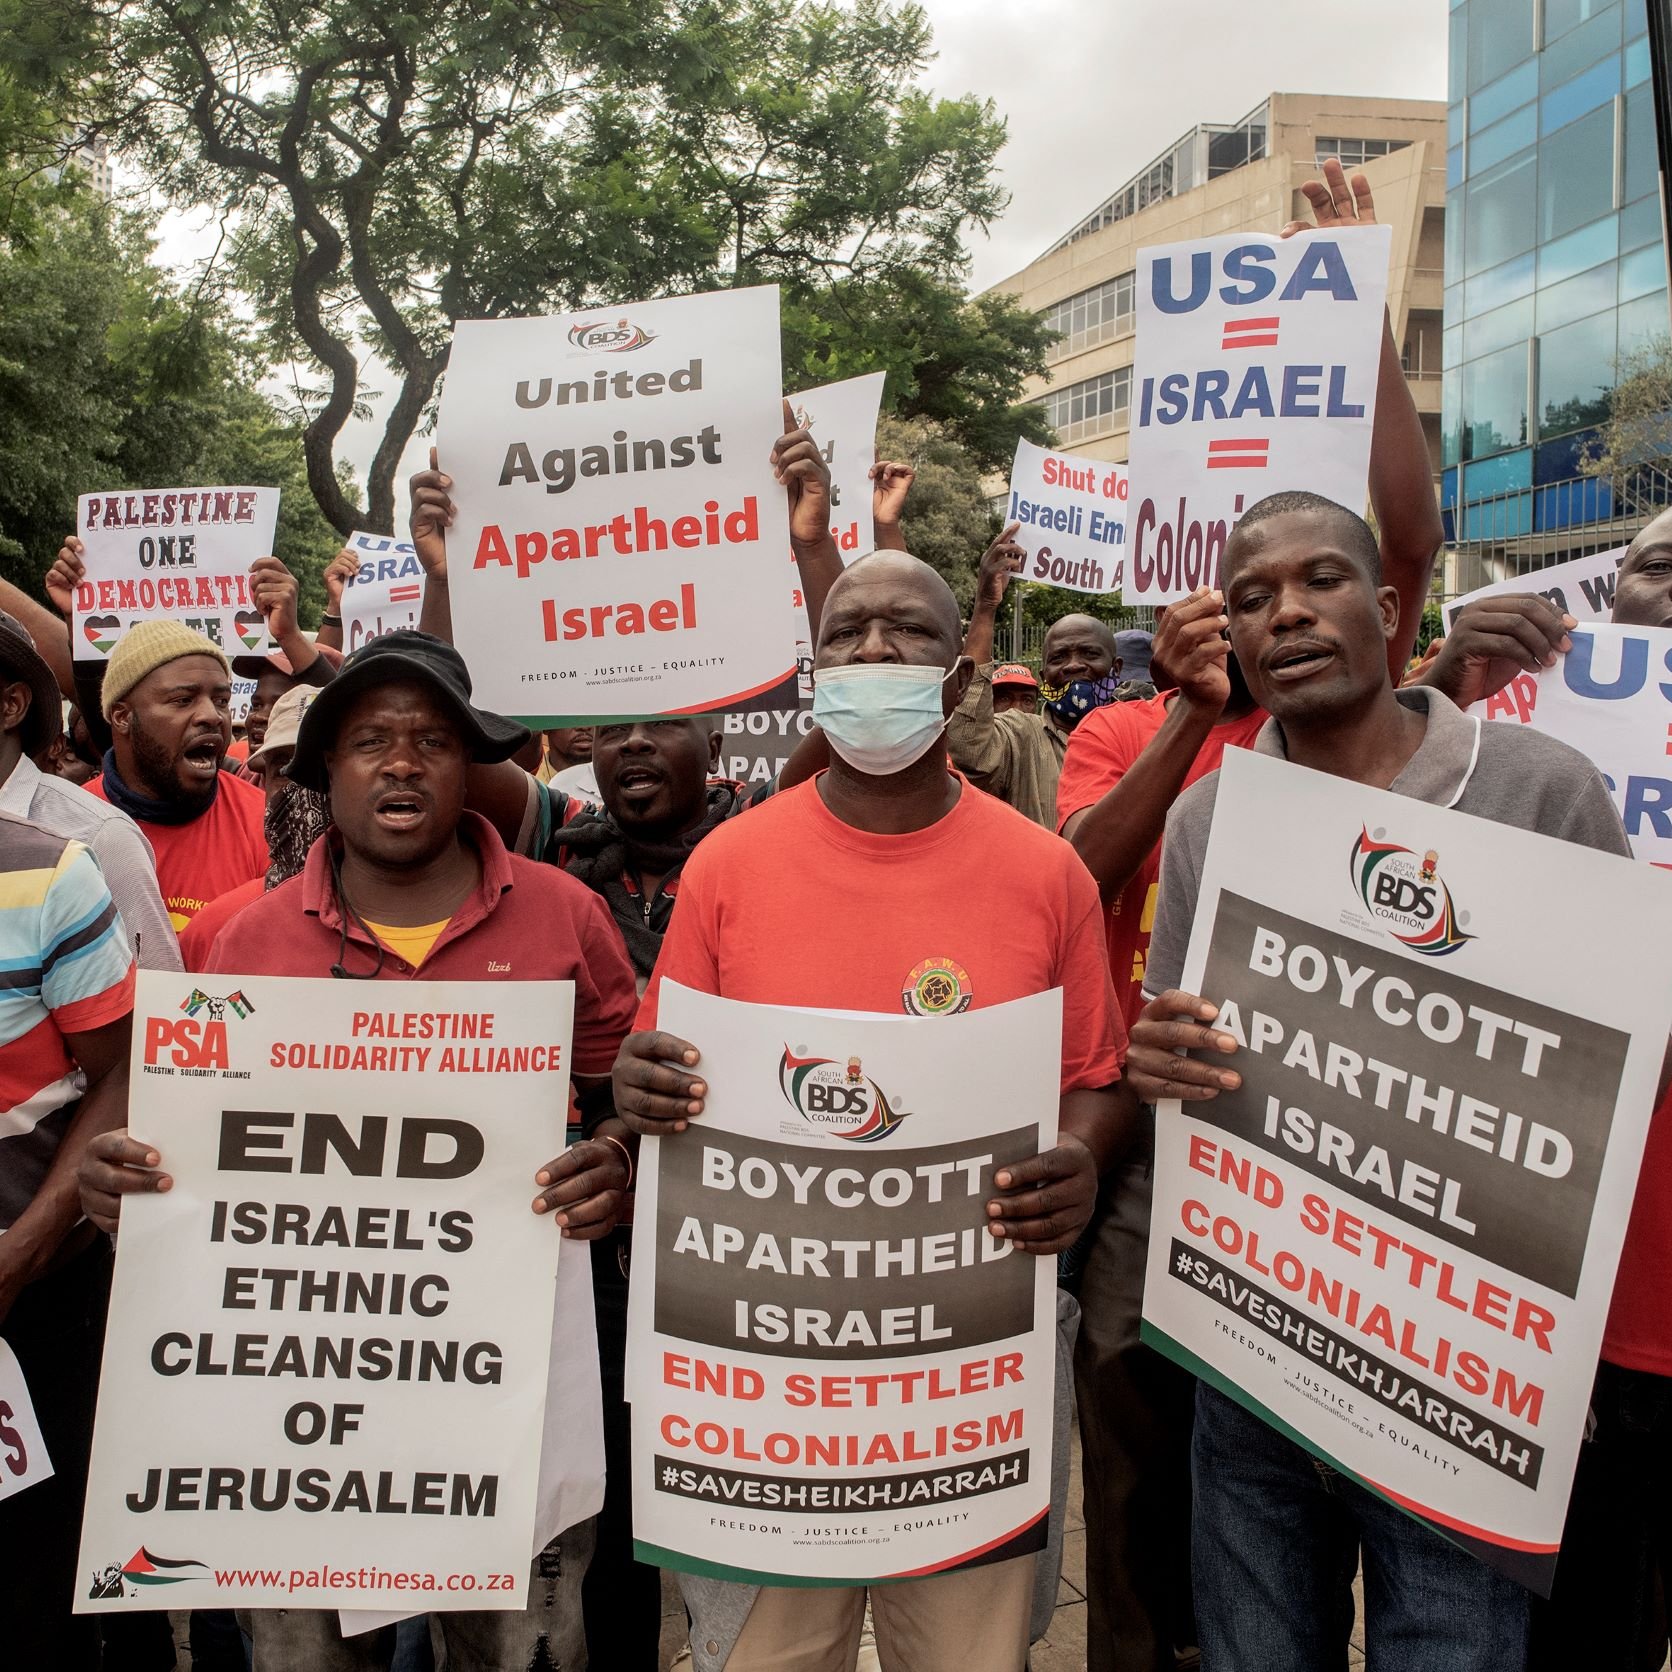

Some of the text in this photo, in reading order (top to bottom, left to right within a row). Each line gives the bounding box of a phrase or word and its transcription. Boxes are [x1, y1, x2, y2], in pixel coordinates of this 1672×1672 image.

[1152, 241, 1358, 314] USA
[588, 329, 630, 345] BDS
[515, 358, 702, 409] United
[1139, 365, 1365, 427] ISRAEL
[498, 425, 722, 494] Against
[1042, 457, 1095, 494] Shut
[86, 491, 257, 531] PALESTINE
[1010, 491, 1126, 545] Israeli Em
[139, 535, 197, 570] ONE
[473, 496, 759, 578] Apartheid
[1033, 546, 1104, 590] South
[542, 583, 697, 642] Israel
[521, 670, 577, 682] FREEDOM
[594, 664, 644, 676] JUSTICE
[663, 657, 725, 670] EQUALITY
[1384, 864, 1416, 879] AFRICAN
[1391, 858, 1415, 870] SOUTH
[168, 897, 208, 910] WORK
[1373, 871, 1437, 919] BDS
[1375, 907, 1425, 931] COALITION
[352, 1012, 494, 1040] PALESTINE
[1249, 926, 1561, 1078] BOYCOTT
[144, 1017, 229, 1069] PSA
[270, 1042, 561, 1073] SOLIDARITY ALLIANCE
[143, 1065, 251, 1079] PALESTINE SOLIDARITY ALLIANCE
[812, 1075, 844, 1085] AFRICAN
[817, 1069, 841, 1078] SOUTH
[1211, 999, 1573, 1179] APARTHEID
[807, 1083, 869, 1115] BDS
[811, 1113, 862, 1124] COALITION
[217, 1110, 485, 1180] END
[1264, 1096, 1476, 1236] ISRAEL
[702, 1146, 993, 1208] BOYCOTT
[210, 1201, 474, 1253] ISRAEL'S
[673, 1216, 1014, 1279] APARTHEID
[1189, 1134, 1556, 1354] END SETTLER
[221, 1267, 450, 1318] ETHNIC
[1180, 1199, 1545, 1428] COLONIALISM
[735, 1300, 952, 1347] ISRAEL
[150, 1331, 503, 1385] CLEANSING
[663, 1351, 1025, 1408] END SETTLER
[1176, 1252, 1529, 1475] #SAVESHEIKHJARRAH
[283, 1401, 365, 1446] OF
[1214, 1320, 1277, 1365] FREEDOM
[1295, 1372, 1355, 1414] JUSTICE
[1379, 1423, 1460, 1476] EQUALITY
[1283, 1377, 1374, 1439] www.sabdscoalition.org.za
[660, 1408, 1024, 1467] COLONIALISM
[125, 1467, 499, 1518] JERUSALEM
[662, 1458, 1021, 1507] #SAVESHEIKHJARRAH
[710, 1518, 782, 1535] FREEDOM
[804, 1526, 868, 1536] JUSTICE
[894, 1512, 969, 1532] EQUALITY
[792, 1536, 890, 1546] www.sabdscoalition.org.za
[214, 1565, 515, 1593] www.palestinesa.co.za
